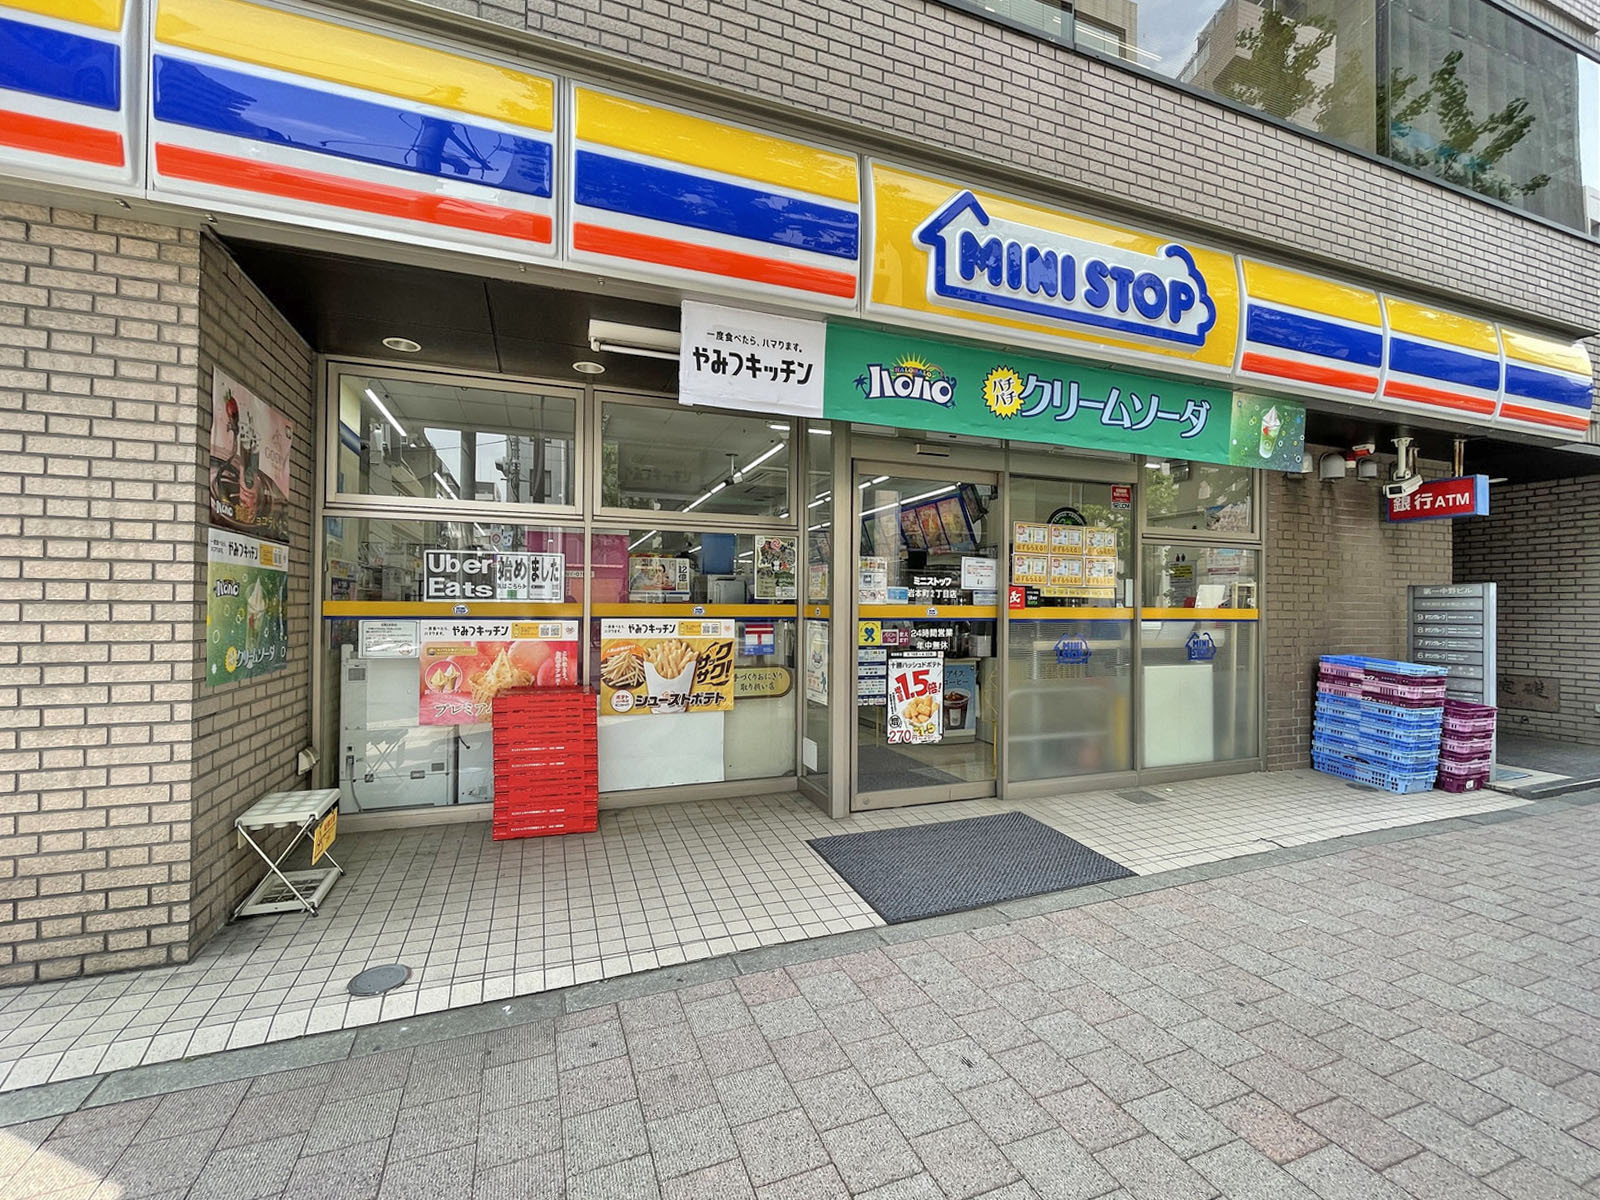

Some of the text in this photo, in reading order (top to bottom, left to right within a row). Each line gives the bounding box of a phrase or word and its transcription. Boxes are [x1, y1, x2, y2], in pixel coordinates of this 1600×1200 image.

[959, 231, 1196, 324] MINI STOP
[706, 331, 803, 353] 一度食べたら、ハマります。
[692, 346, 814, 385] やみつキッチン
[1019, 374, 1211, 439] クリームソーダ
[1393, 492, 1470, 512] 銀行ATM
[428, 554, 493, 574] Uber
[498, 556, 560, 582] 始めました
[428, 577, 494, 598] Eats
[452, 626, 510, 636] やみつキッチン
[628, 624, 677, 634] やみつキッチン
[910, 628, 953, 638] 24時間営業
[916, 641, 949, 650] 年中無休
[635, 691, 727, 708] シューストポテト
